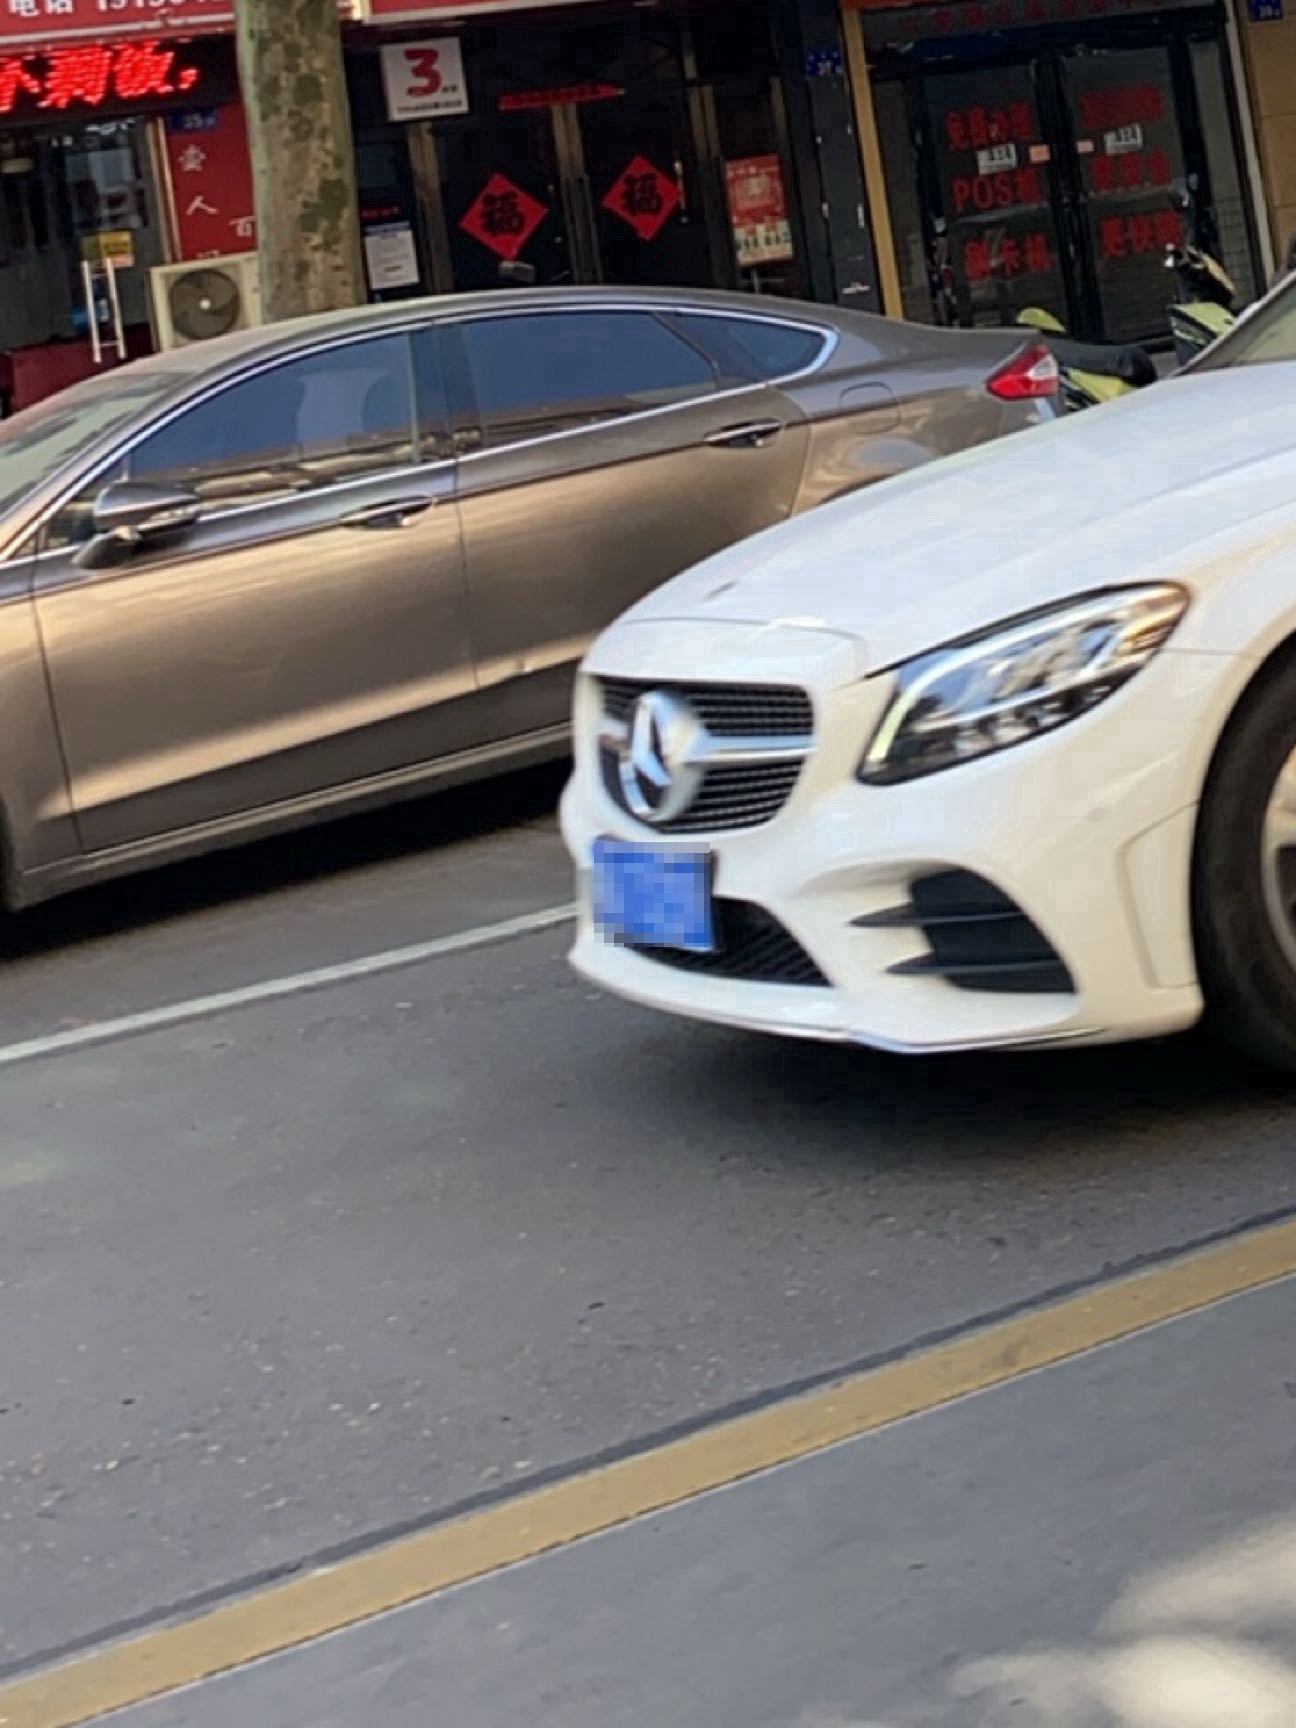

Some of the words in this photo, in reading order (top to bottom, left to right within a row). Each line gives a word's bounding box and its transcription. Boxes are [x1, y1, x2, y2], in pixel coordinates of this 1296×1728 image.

[404, 49, 442, 96] 3
[481, 191, 526, 238] 福
[622, 172, 664, 217] 福
